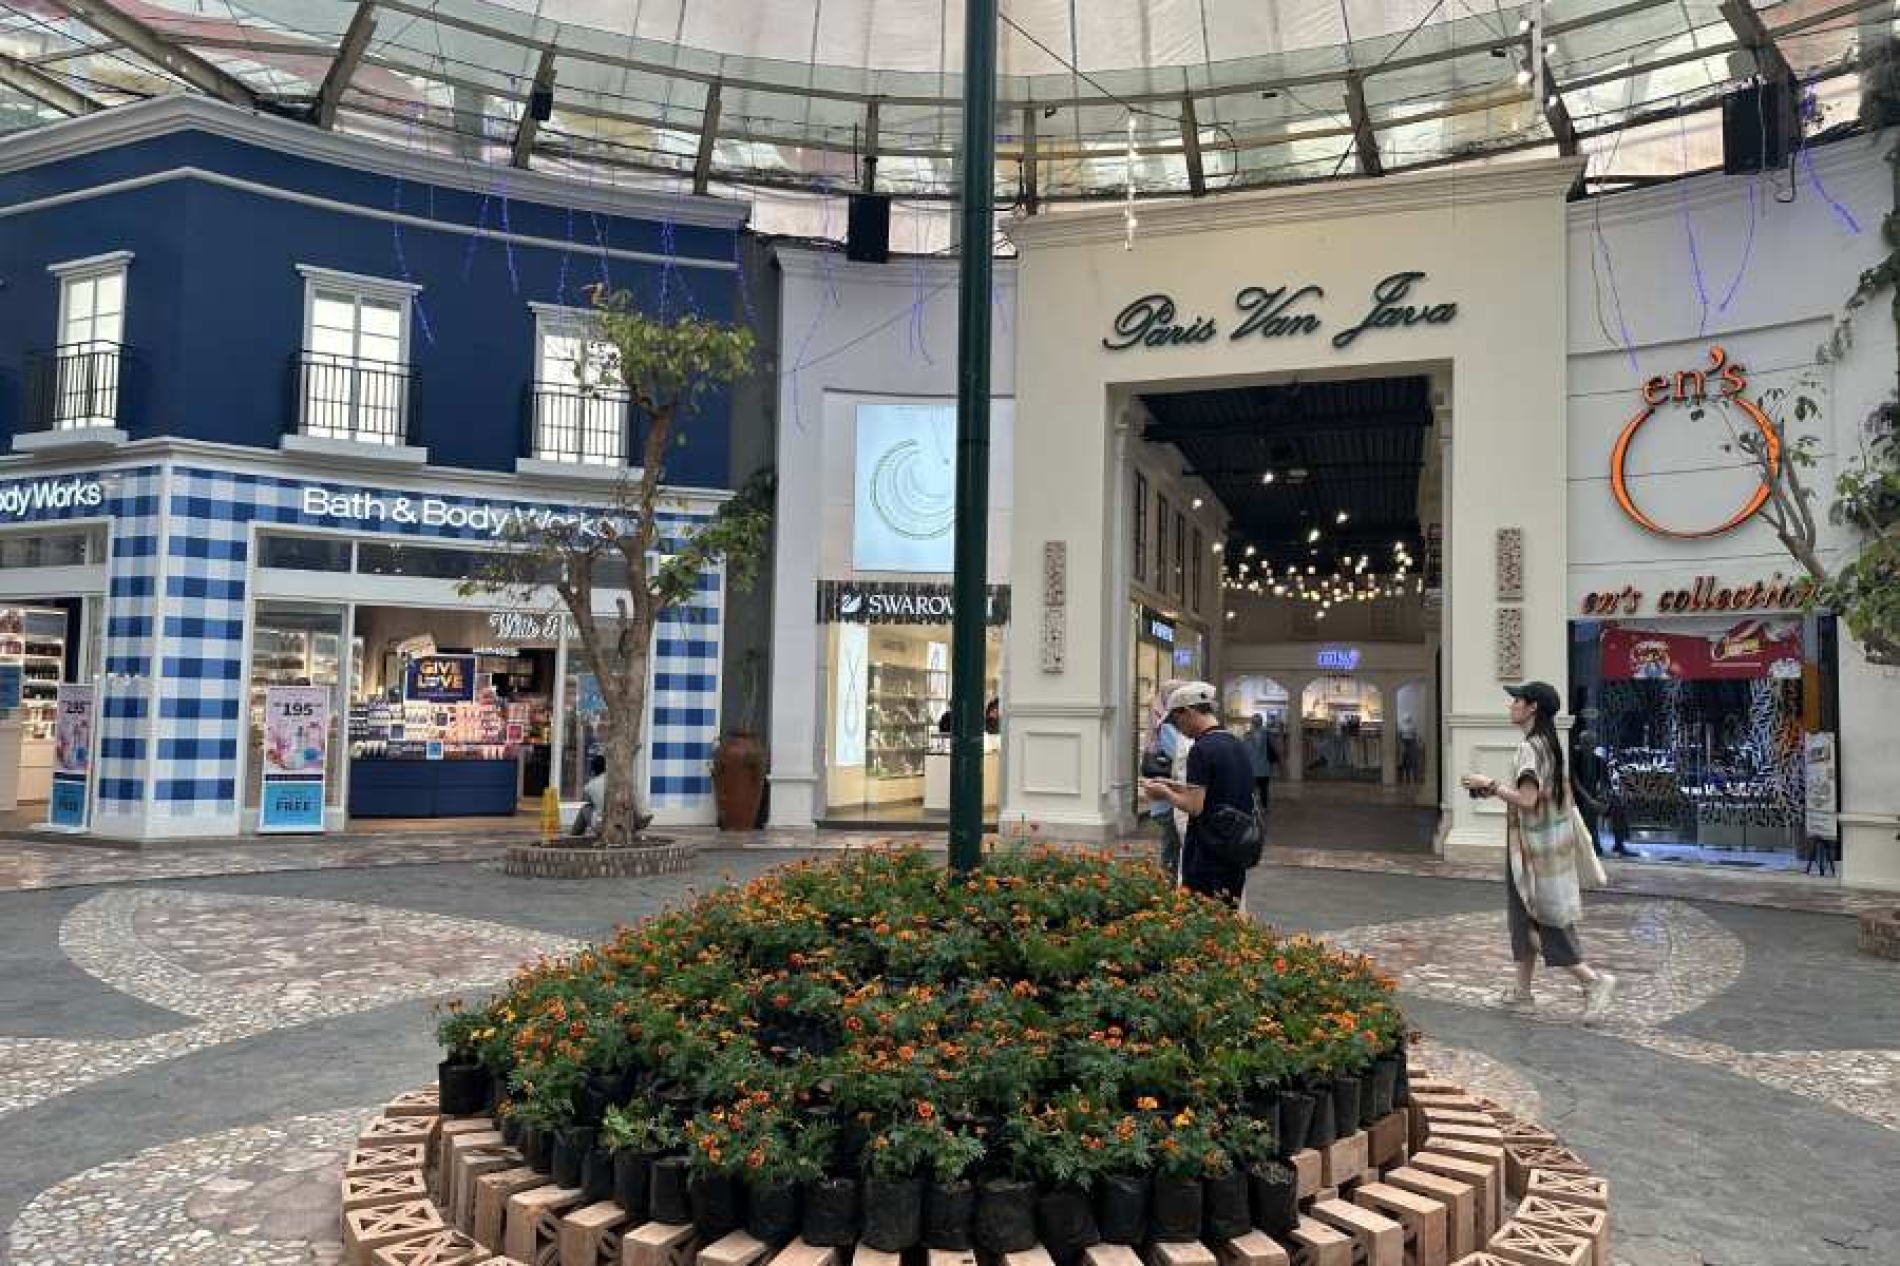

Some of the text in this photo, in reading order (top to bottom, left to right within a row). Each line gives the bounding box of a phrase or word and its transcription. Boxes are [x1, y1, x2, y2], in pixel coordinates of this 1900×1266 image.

[1102, 271, 1458, 351] Paris Van Java
[1643, 345, 1747, 406] en's
[33, 478, 102, 509] Works
[303, 486, 385, 521] Bath
[392, 497, 417, 524] &
[423, 499, 510, 537] Body
[283, 702, 313, 716] 195
